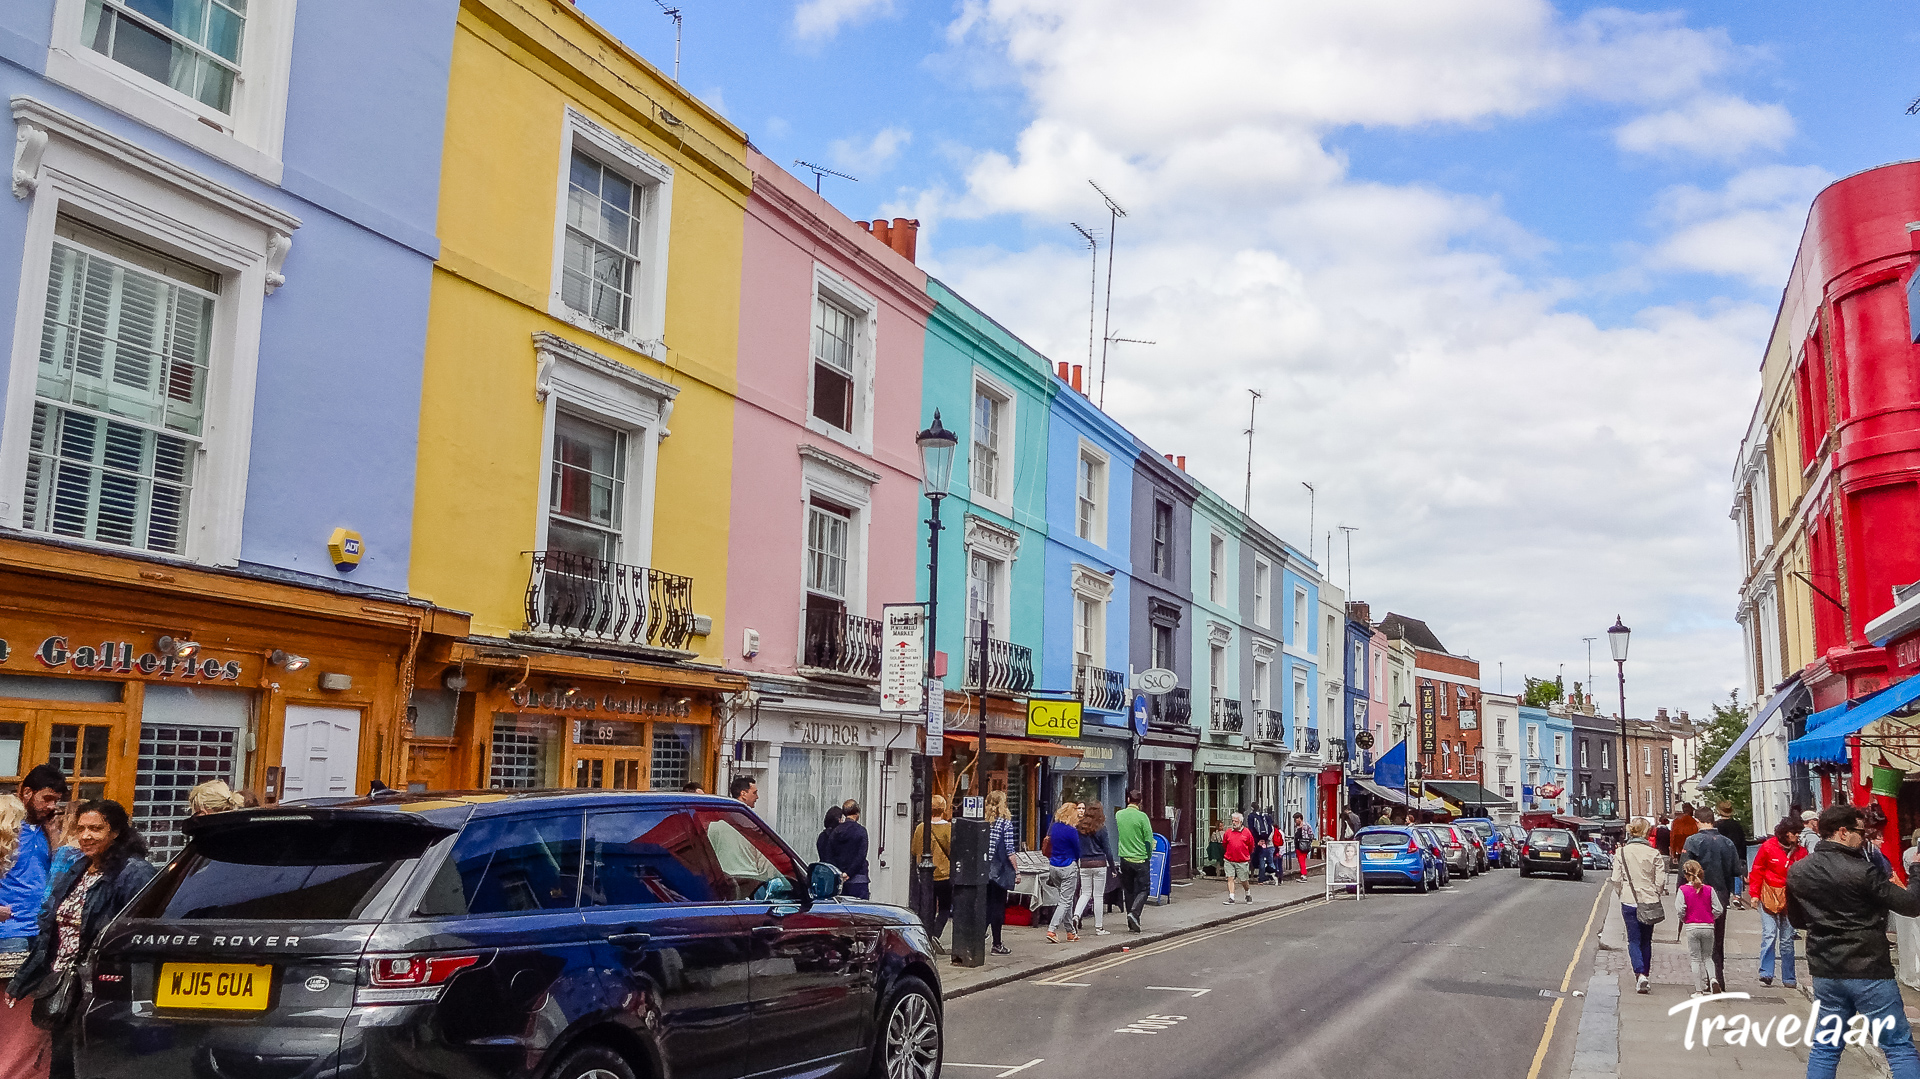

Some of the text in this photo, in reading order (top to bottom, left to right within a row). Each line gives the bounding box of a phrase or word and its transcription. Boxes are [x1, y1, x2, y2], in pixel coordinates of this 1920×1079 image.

[345, 542, 360, 553] ADT
[35, 635, 241, 681] Galleries
[1144, 674, 1171, 689] S&C
[511, 687, 692, 718] Chelsea Galleries
[1424, 690, 1433, 708] THE
[1031, 705, 1079, 730] Café
[1424, 712, 1433, 738] GOLD
[598, 726, 614, 740] 69
[801, 722, 859, 746] AUTHOR
[131, 934, 301, 948] RANGE ROVER
[170, 971, 254, 997] WJ15 GUA
